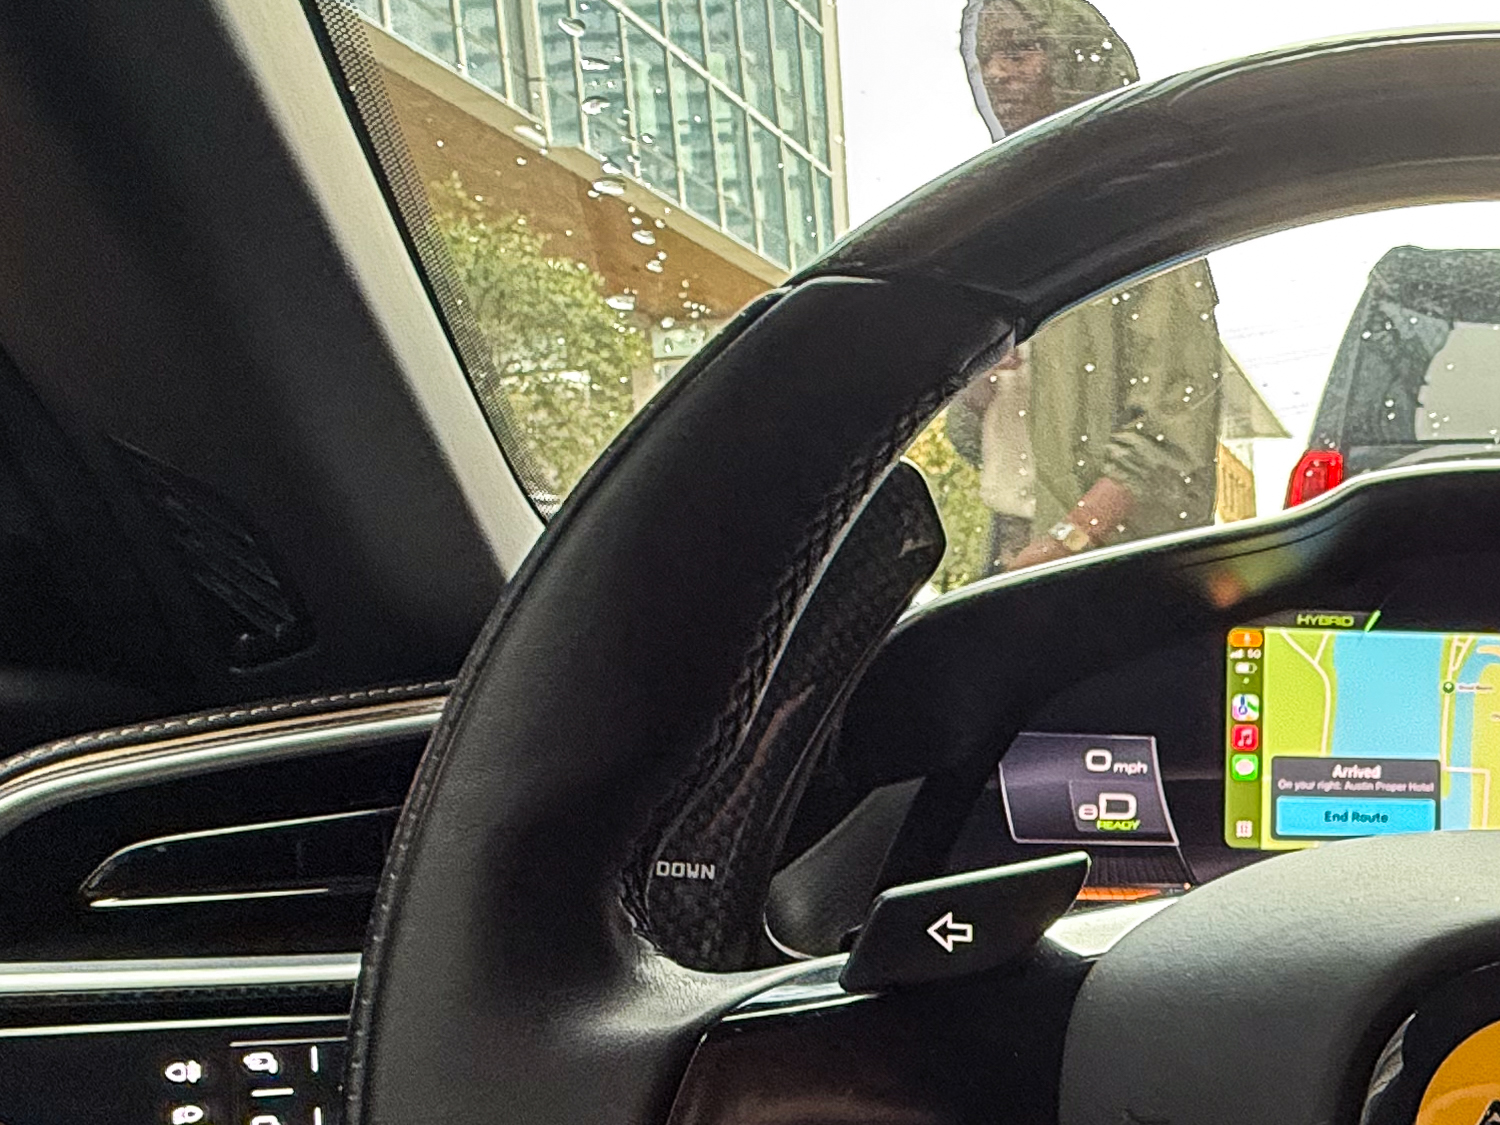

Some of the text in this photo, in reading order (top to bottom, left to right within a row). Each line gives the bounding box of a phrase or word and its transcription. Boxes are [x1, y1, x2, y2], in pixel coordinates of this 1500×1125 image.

[1113, 761, 1148, 775] mph
[1332, 764, 1382, 779] Arrived
[1294, 780, 1315, 792] your
[1324, 810, 1388, 823] End Route
[1096, 820, 1140, 831] READY
[656, 861, 716, 880] DOWN
